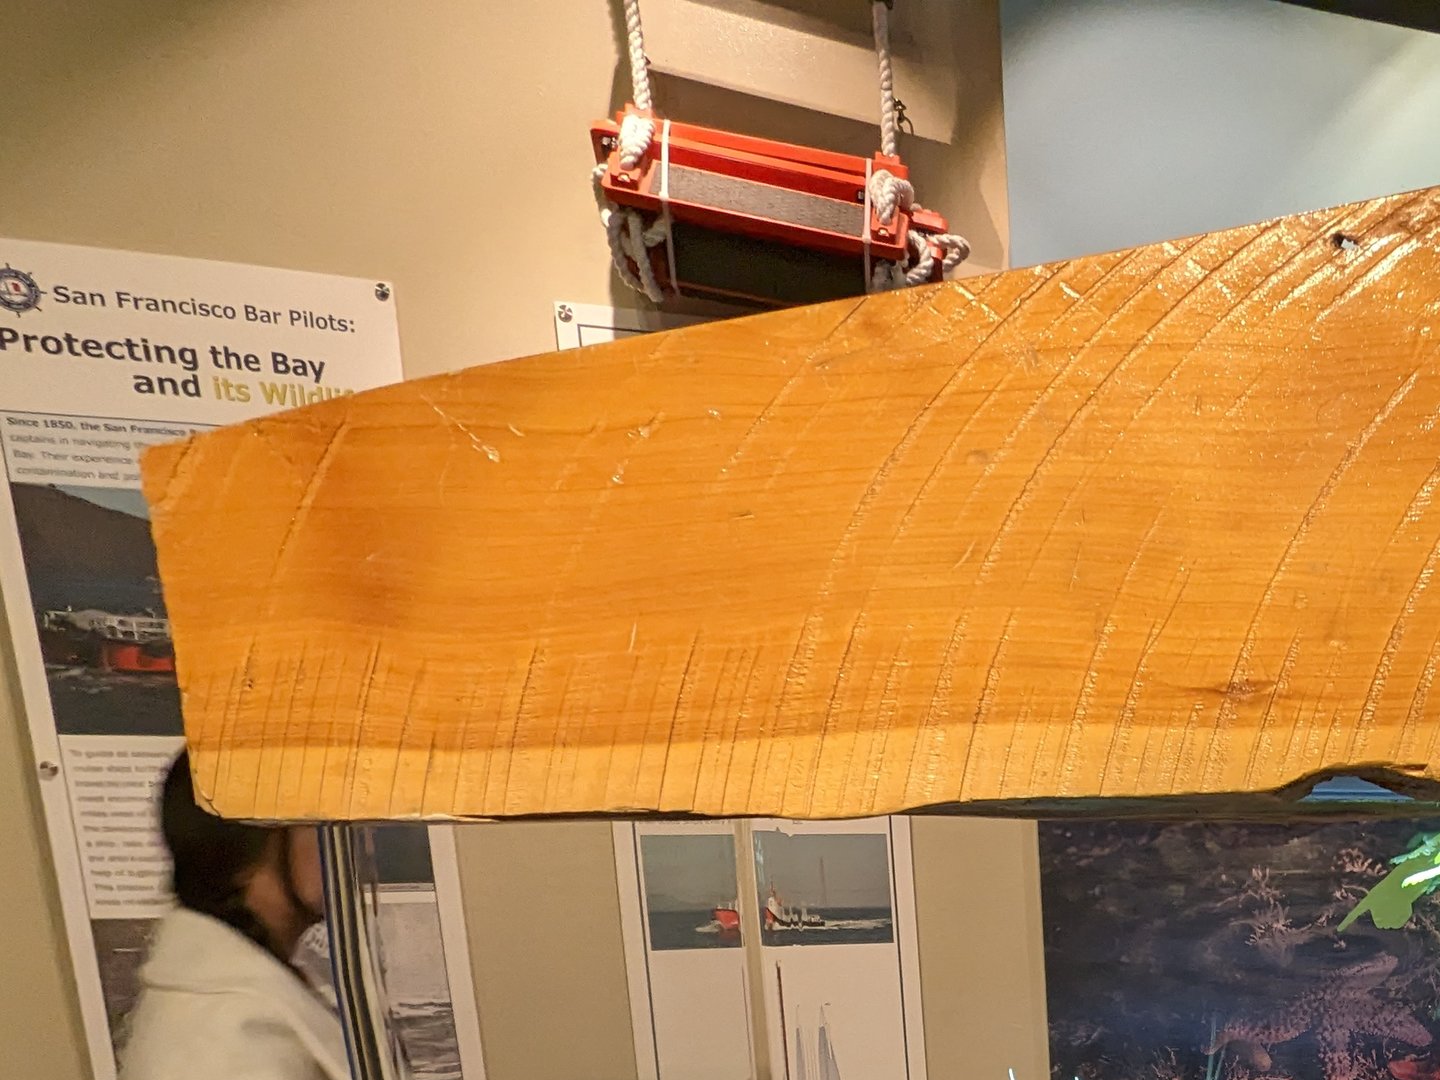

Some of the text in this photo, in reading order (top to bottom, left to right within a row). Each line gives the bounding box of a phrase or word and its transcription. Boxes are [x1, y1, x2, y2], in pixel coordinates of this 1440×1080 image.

[53, 285, 355, 332] San Francisco Bar Pilots:
[0, 327, 325, 383] Protecting the Bay
[133, 374, 201, 398] and
[212, 376, 250, 402] its
[7, 417, 39, 427] Since
[81, 422, 100, 431] the
[103, 423, 127, 432] San
[130, 424, 186, 436] Francisco
